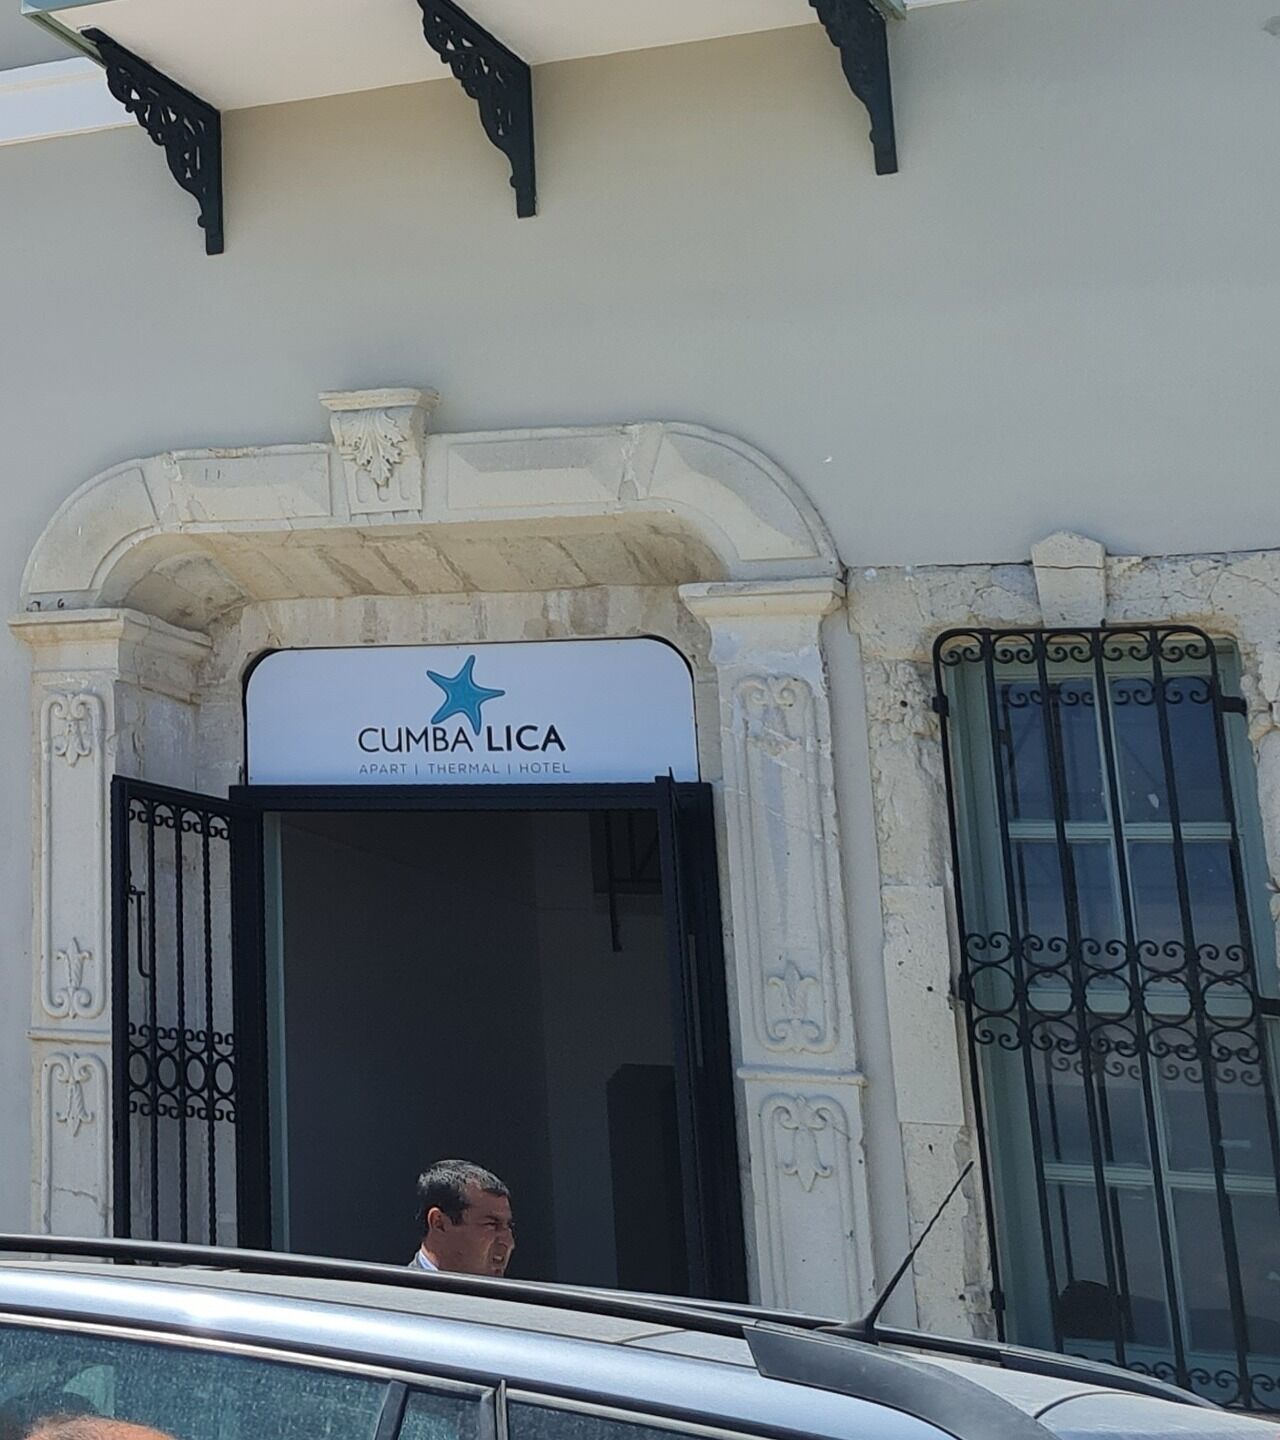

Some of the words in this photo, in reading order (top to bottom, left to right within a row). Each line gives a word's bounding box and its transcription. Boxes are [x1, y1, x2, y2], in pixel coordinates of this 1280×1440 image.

[357, 726, 475, 753] CUMBA
[486, 724, 567, 753] LICA
[358, 763, 408, 775] APART
[427, 762, 501, 775] THERMAL
[518, 762, 572, 774] HOTEL
